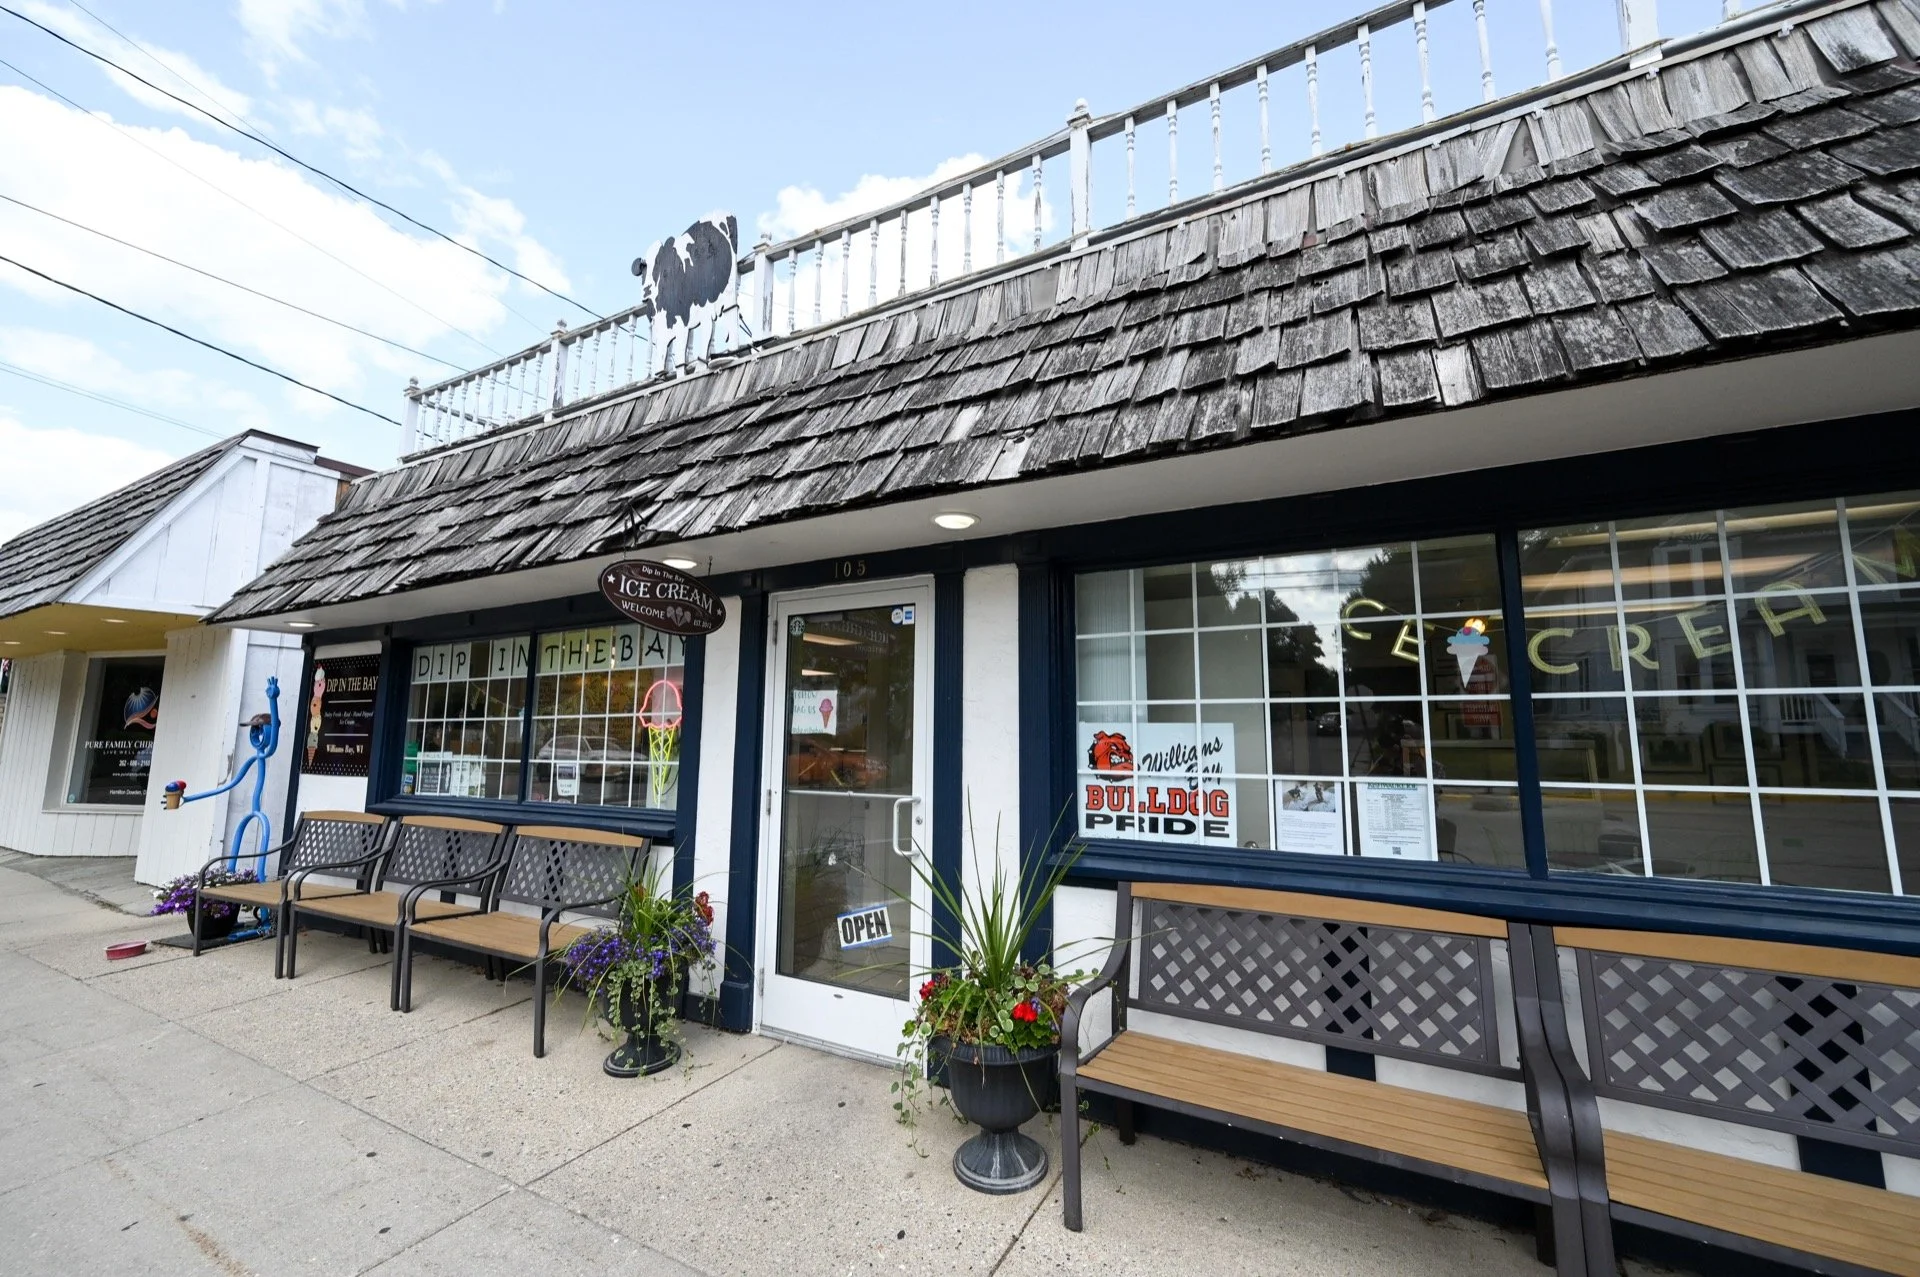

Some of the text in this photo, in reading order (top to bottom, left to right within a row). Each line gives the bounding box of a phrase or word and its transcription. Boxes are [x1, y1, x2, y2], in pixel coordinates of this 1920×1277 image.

[642, 565, 653, 575] Dip
[662, 572, 674, 581] The
[835, 561, 866, 578] 105
[619, 574, 713, 615] ICE CREAM
[621, 600, 666, 620] WELCOME
[418, 652, 466, 676] DIP
[498, 643, 530, 672] IN
[545, 639, 607, 669] THE
[326, 676, 378, 692] DIP IN THE BAY
[84, 741, 104, 749] PURE
[105, 741, 133, 749] FAMILY
[326, 744, 344, 753] Williams
[1142, 736, 1223, 772] Williams
[1086, 785, 1229, 818] BULLDOG
[1085, 813, 1230, 838] PRIDE
[841, 909, 888, 945] OPEN
